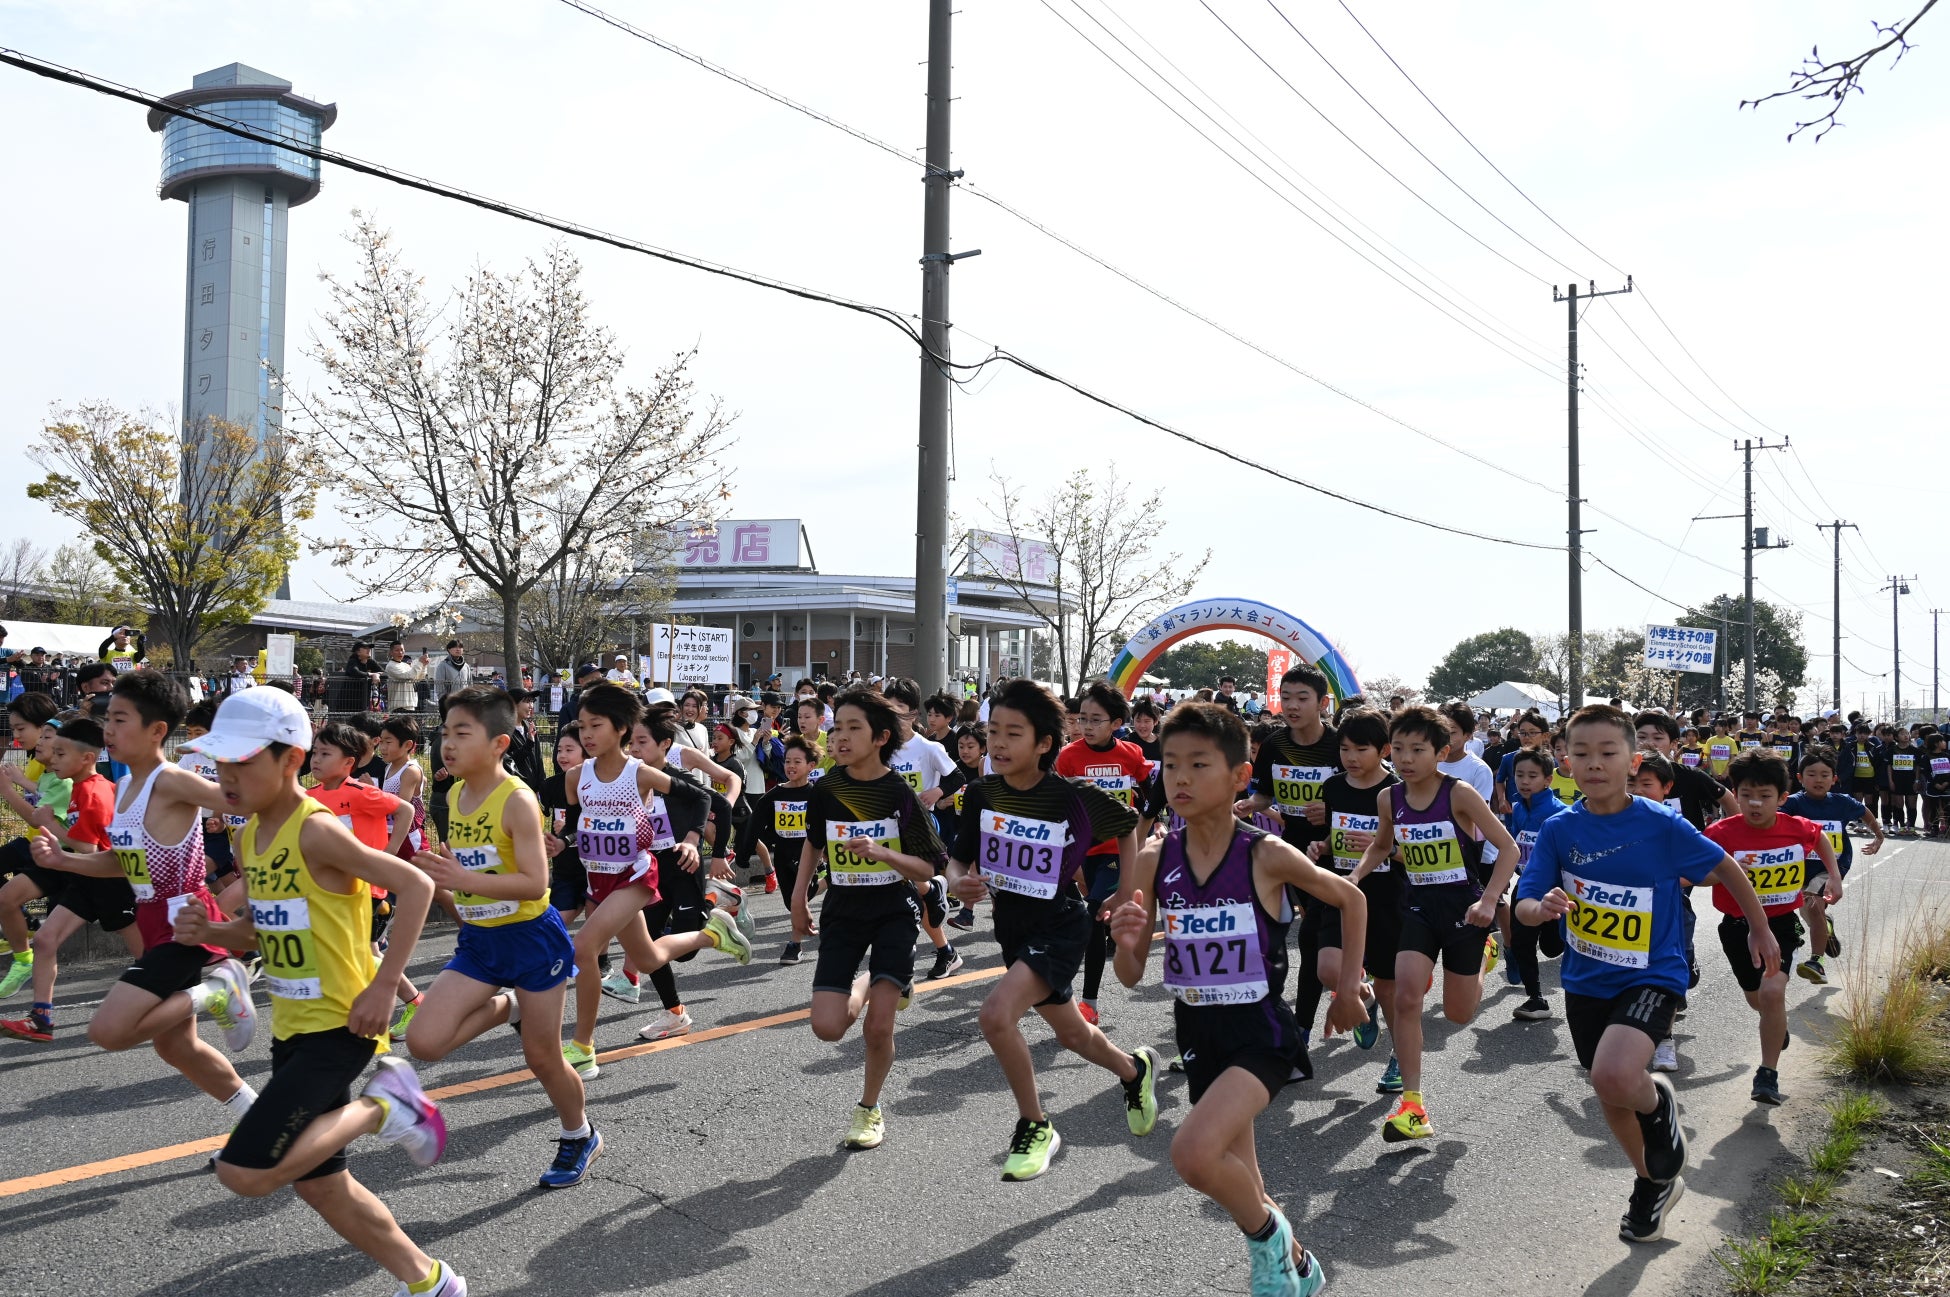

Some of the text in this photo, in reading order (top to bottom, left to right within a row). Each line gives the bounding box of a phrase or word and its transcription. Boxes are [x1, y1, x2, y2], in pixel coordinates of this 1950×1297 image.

[684, 523, 771, 565] 売店
[661, 627, 728, 643] スタート (START)
[1650, 627, 1714, 644] 小学生女子の部
[676, 643, 712, 653] 小学生の部
[1649, 640, 1680, 648] (Elementary
[657, 651, 729, 663] (Eleentary school section)
[1648, 647, 1713, 664] ジョギングの部
[676, 663, 710, 672] ジョギング
[678, 673, 709, 682] (Jogging)
[1269, 655, 1286, 709] 営業中
[1087, 767, 1121, 777] KUMA
[1278, 782, 1324, 802] 8004
[778, 814, 805, 827] 821
[581, 834, 631, 856] 8108
[986, 837, 1053, 874] 8103
[1404, 841, 1451, 867] 8007
[1571, 900, 1642, 942] 8220
[1168, 939, 1247, 976] 8127
